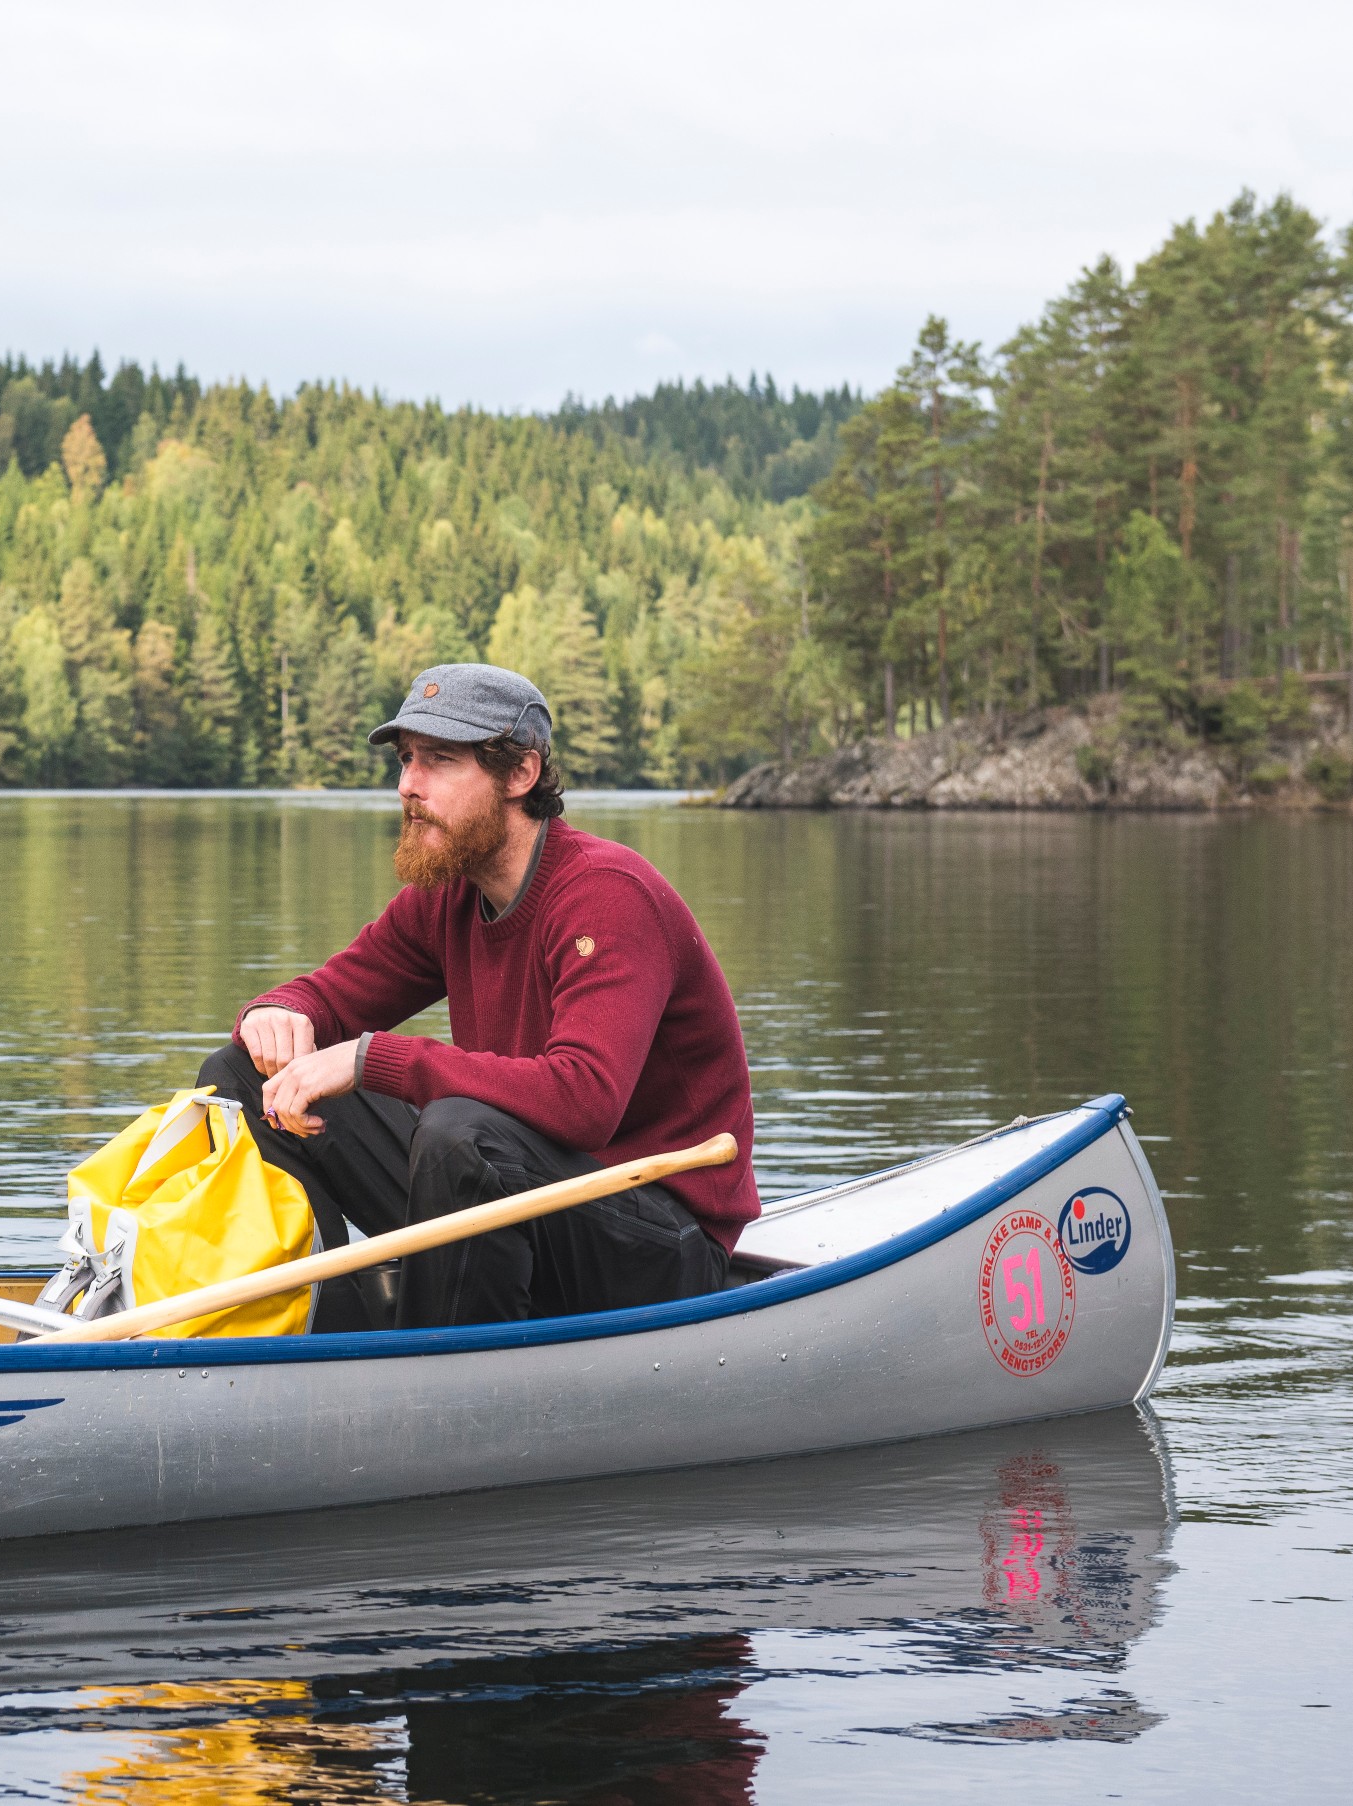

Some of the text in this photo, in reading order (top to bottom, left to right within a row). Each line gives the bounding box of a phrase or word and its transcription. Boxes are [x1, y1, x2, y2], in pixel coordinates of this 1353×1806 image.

[1068, 1199, 1122, 1245] Linder
[982, 1216, 1072, 1327] SILVERLAKE CAMP & KANOT
[1002, 1248, 1045, 1332] 51
[1001, 1330, 1065, 1371] BENGTSFORS
[1014, 1328, 1051, 1351] 0531-12173
[1026, 1329, 1038, 1340] TEL
